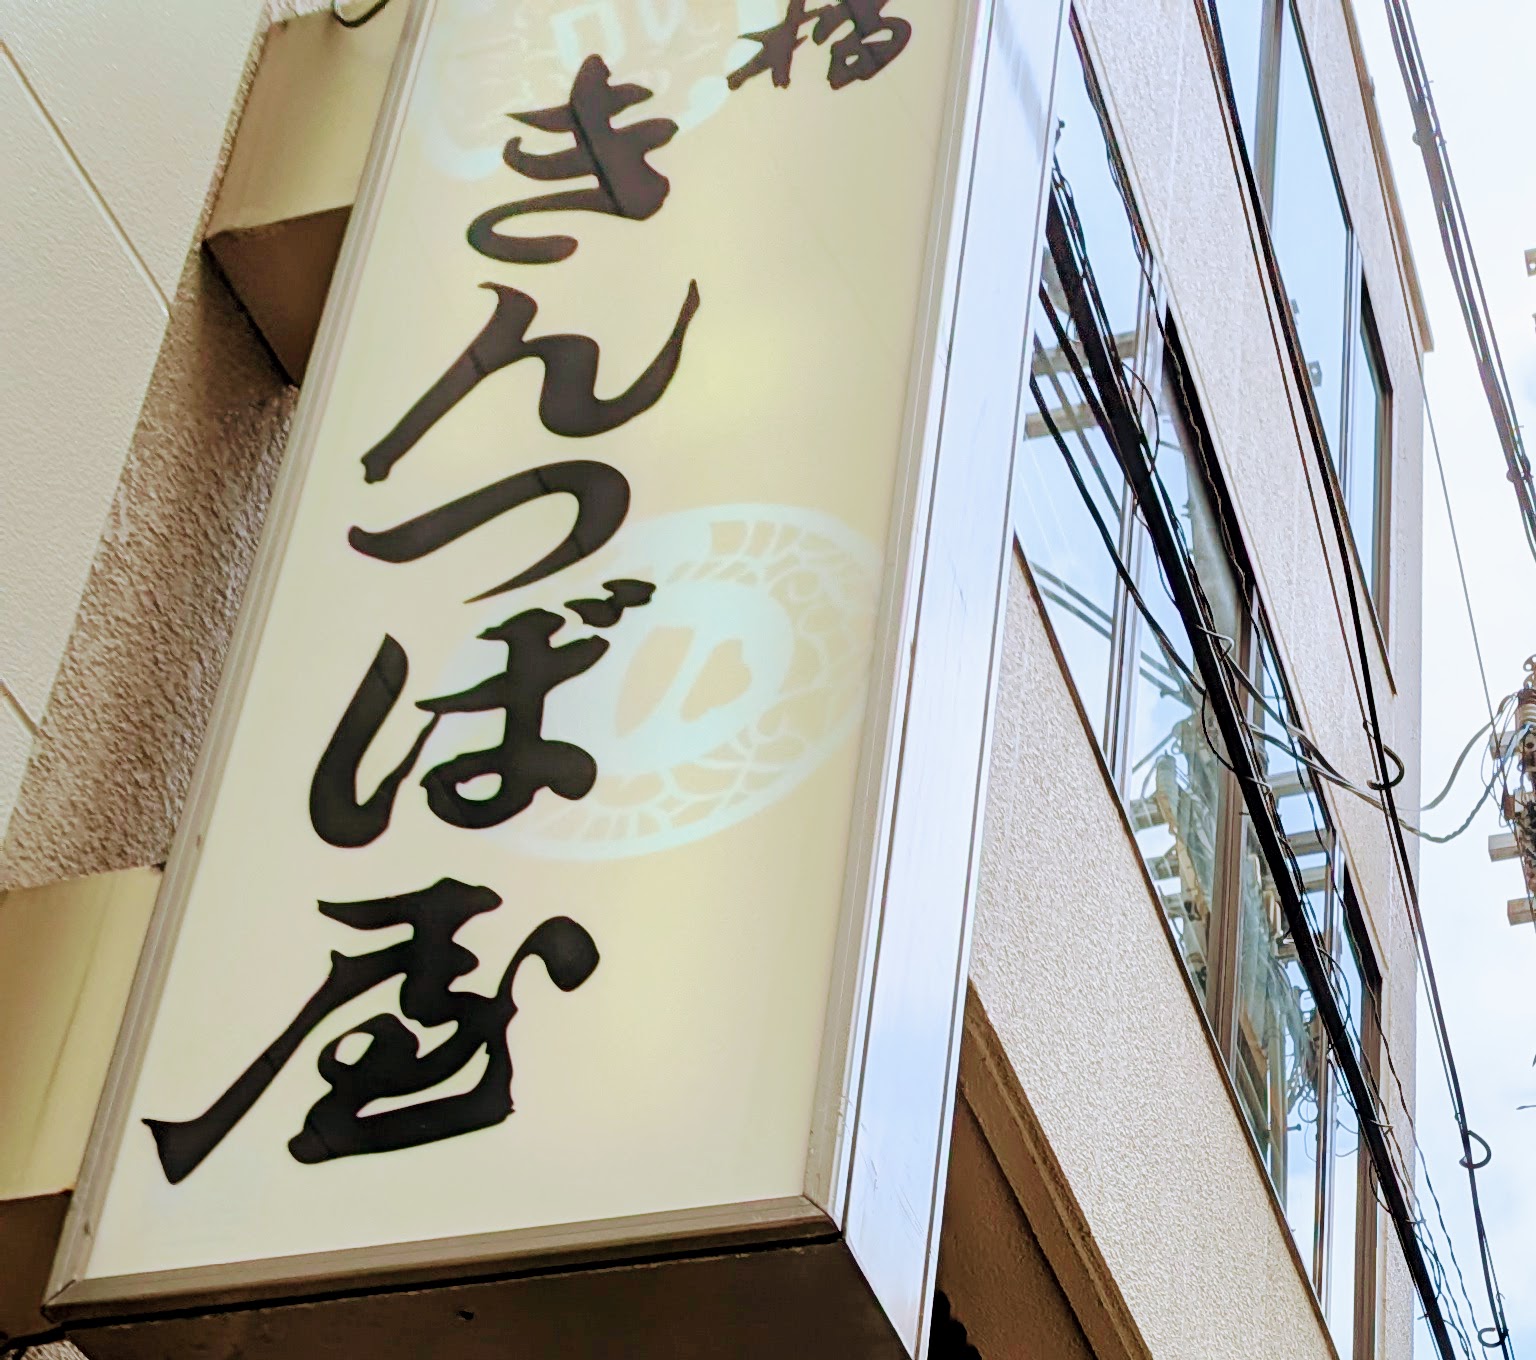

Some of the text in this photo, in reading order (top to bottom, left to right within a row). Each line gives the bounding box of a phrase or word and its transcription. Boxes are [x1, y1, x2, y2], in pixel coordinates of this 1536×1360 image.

[141, 56, 699, 1185] きんつば屋
